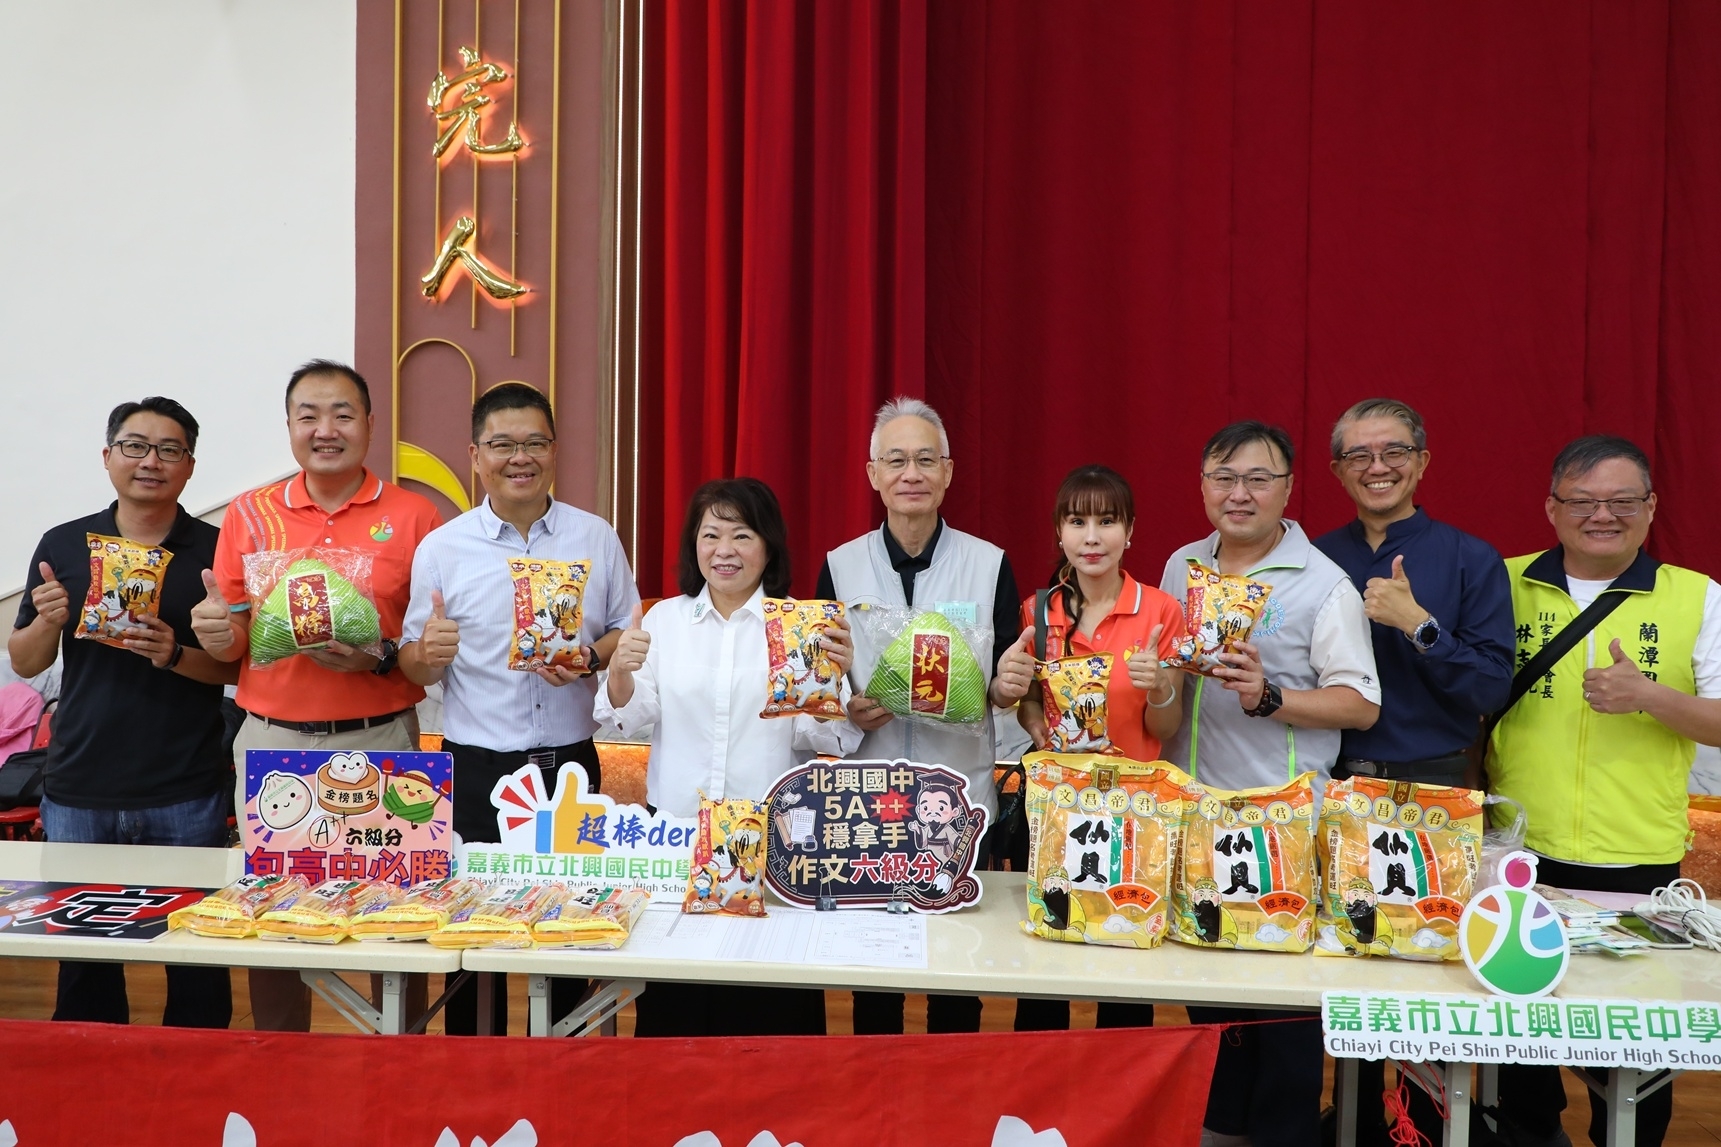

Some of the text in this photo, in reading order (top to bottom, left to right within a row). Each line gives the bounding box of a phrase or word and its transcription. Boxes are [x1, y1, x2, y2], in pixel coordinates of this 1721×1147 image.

[1538, 612, 1556, 622] 114
[1539, 624, 1556, 698] 家長會長
[807, 768, 915, 794] 北興國中
[325, 788, 379, 804] 金榜題名
[824, 794, 904, 820] 5A++
[1058, 788, 1151, 812] 文昌帝君
[1353, 798, 1443, 826] 文昌帝君
[345, 827, 403, 847] 六級分
[576, 812, 697, 849] 超棒der
[822, 821, 909, 850] 穩拿手
[248, 846, 451, 884] 包高中必勝
[1069, 820, 1111, 883] 仙貝
[1214, 831, 1260, 895] 仙貝
[1372, 831, 1422, 896] 仙貝
[787, 852, 941, 885] 作文六級分
[1113, 889, 1151, 905] 經濟包
[1265, 896, 1301, 911] 經濟包
[1423, 902, 1461, 918] 經濟包
[1327, 996, 1721, 1043] 嘉義市立北興國民中學
[1330, 1037, 1382, 1053] Chiayi
[1389, 1040, 1423, 1058] City
[1429, 1041, 1456, 1056] Pei
[1462, 1042, 1500, 1058] Shin
[1506, 1044, 1559, 1060] Public
[1563, 1046, 1617, 1062] Junior
[1623, 1047, 1663, 1066] High
